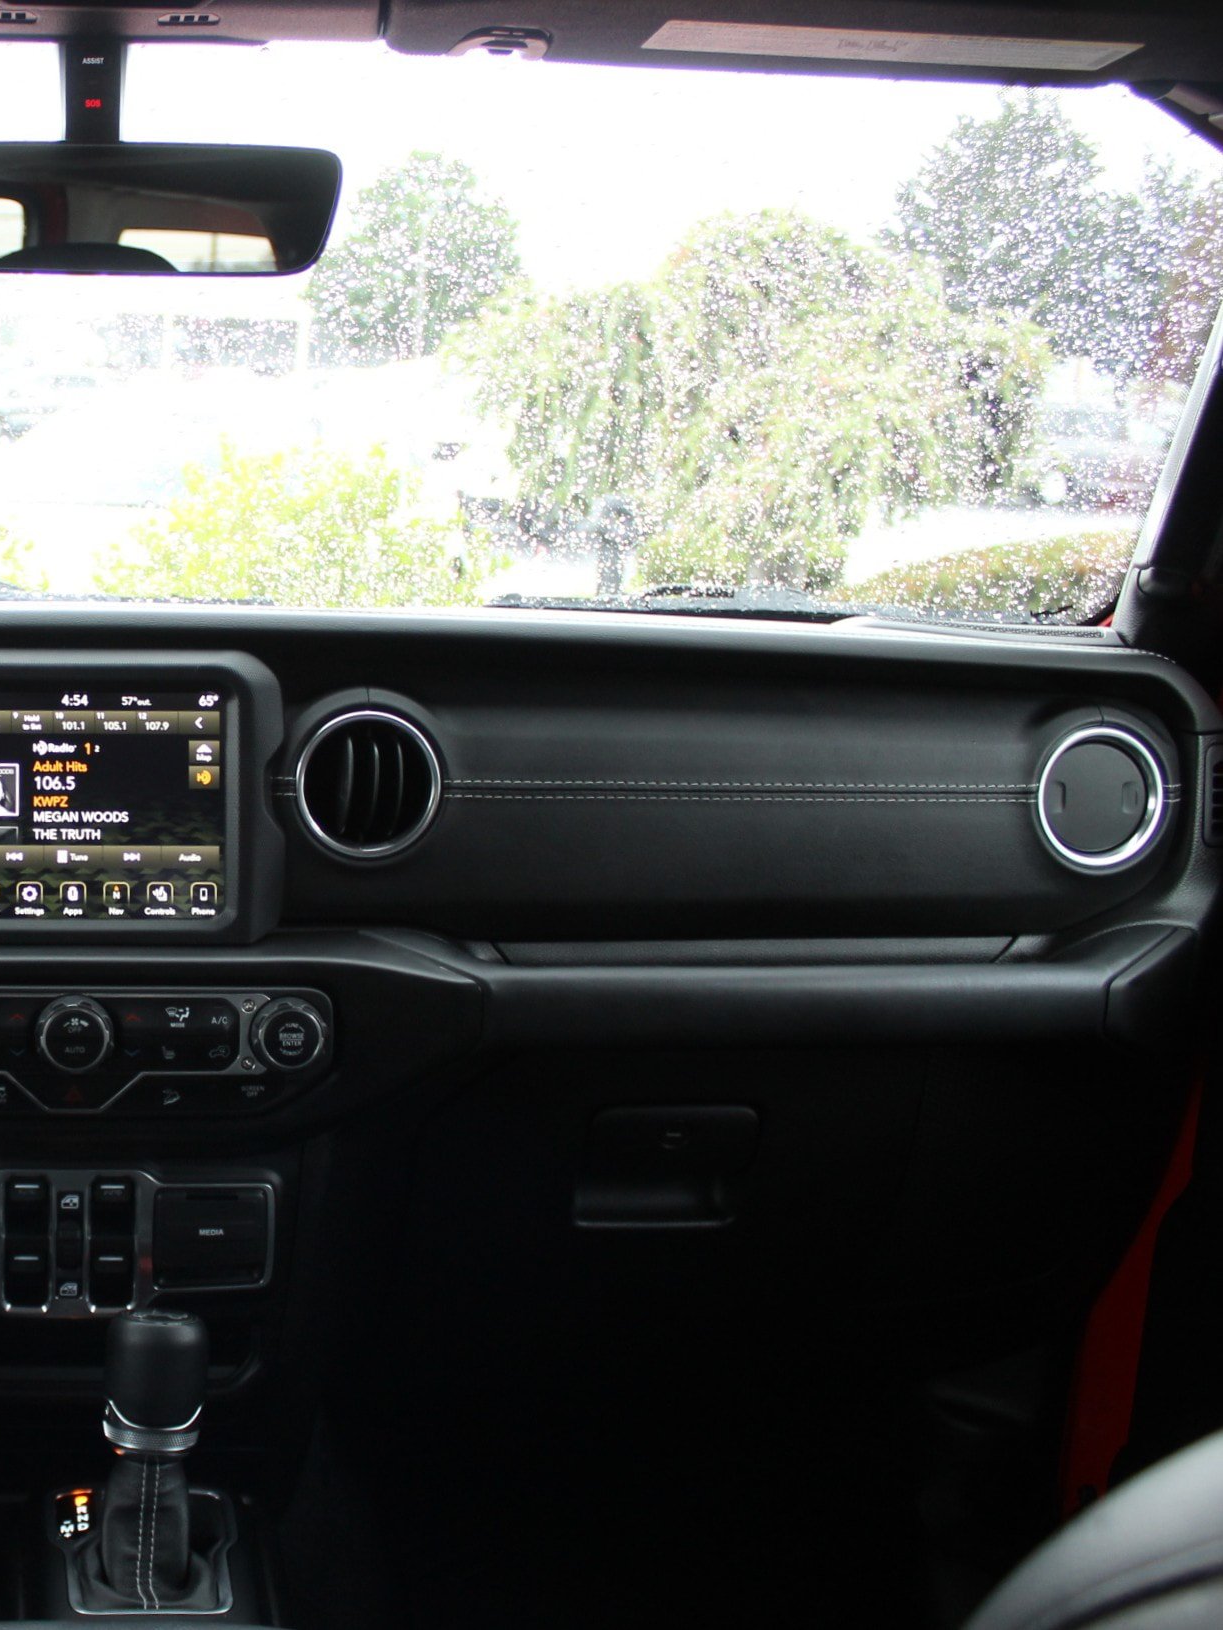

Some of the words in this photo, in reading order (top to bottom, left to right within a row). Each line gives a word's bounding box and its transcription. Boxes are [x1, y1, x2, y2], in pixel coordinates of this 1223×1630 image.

[85, 99, 101, 108] SOS
[61, 694, 89, 706] 4:54
[62, 721, 85, 731] 101.1
[103, 721, 127, 731] 105.1
[145, 721, 170, 731] 107.9
[48, 743, 74, 753] Radio
[84, 742, 91, 756] 1
[94, 745, 100, 753] 2
[32, 760, 64, 773] Adult
[65, 760, 88, 773] Hits
[34, 776, 76, 791] 106.5
[33, 796, 69, 808] KWPZ
[33, 811, 79, 823] MEGAN
[80, 811, 129, 823] WOODS
[32, 828, 58, 840] THE
[59, 828, 101, 840] TRUTH
[70, 853, 89, 862] Tune
[178, 853, 202, 862] Audio
[14, 906, 45, 916] Settings
[63, 907, 83, 916] Apps
[108, 907, 125, 915] Nav
[144, 906, 176, 916] Controls
[191, 907, 216, 916] Phone
[211, 1016, 228, 1025] A/C
[279, 1032, 304, 1040] BROWSE
[199, 1228, 224, 1236] MEDIA
